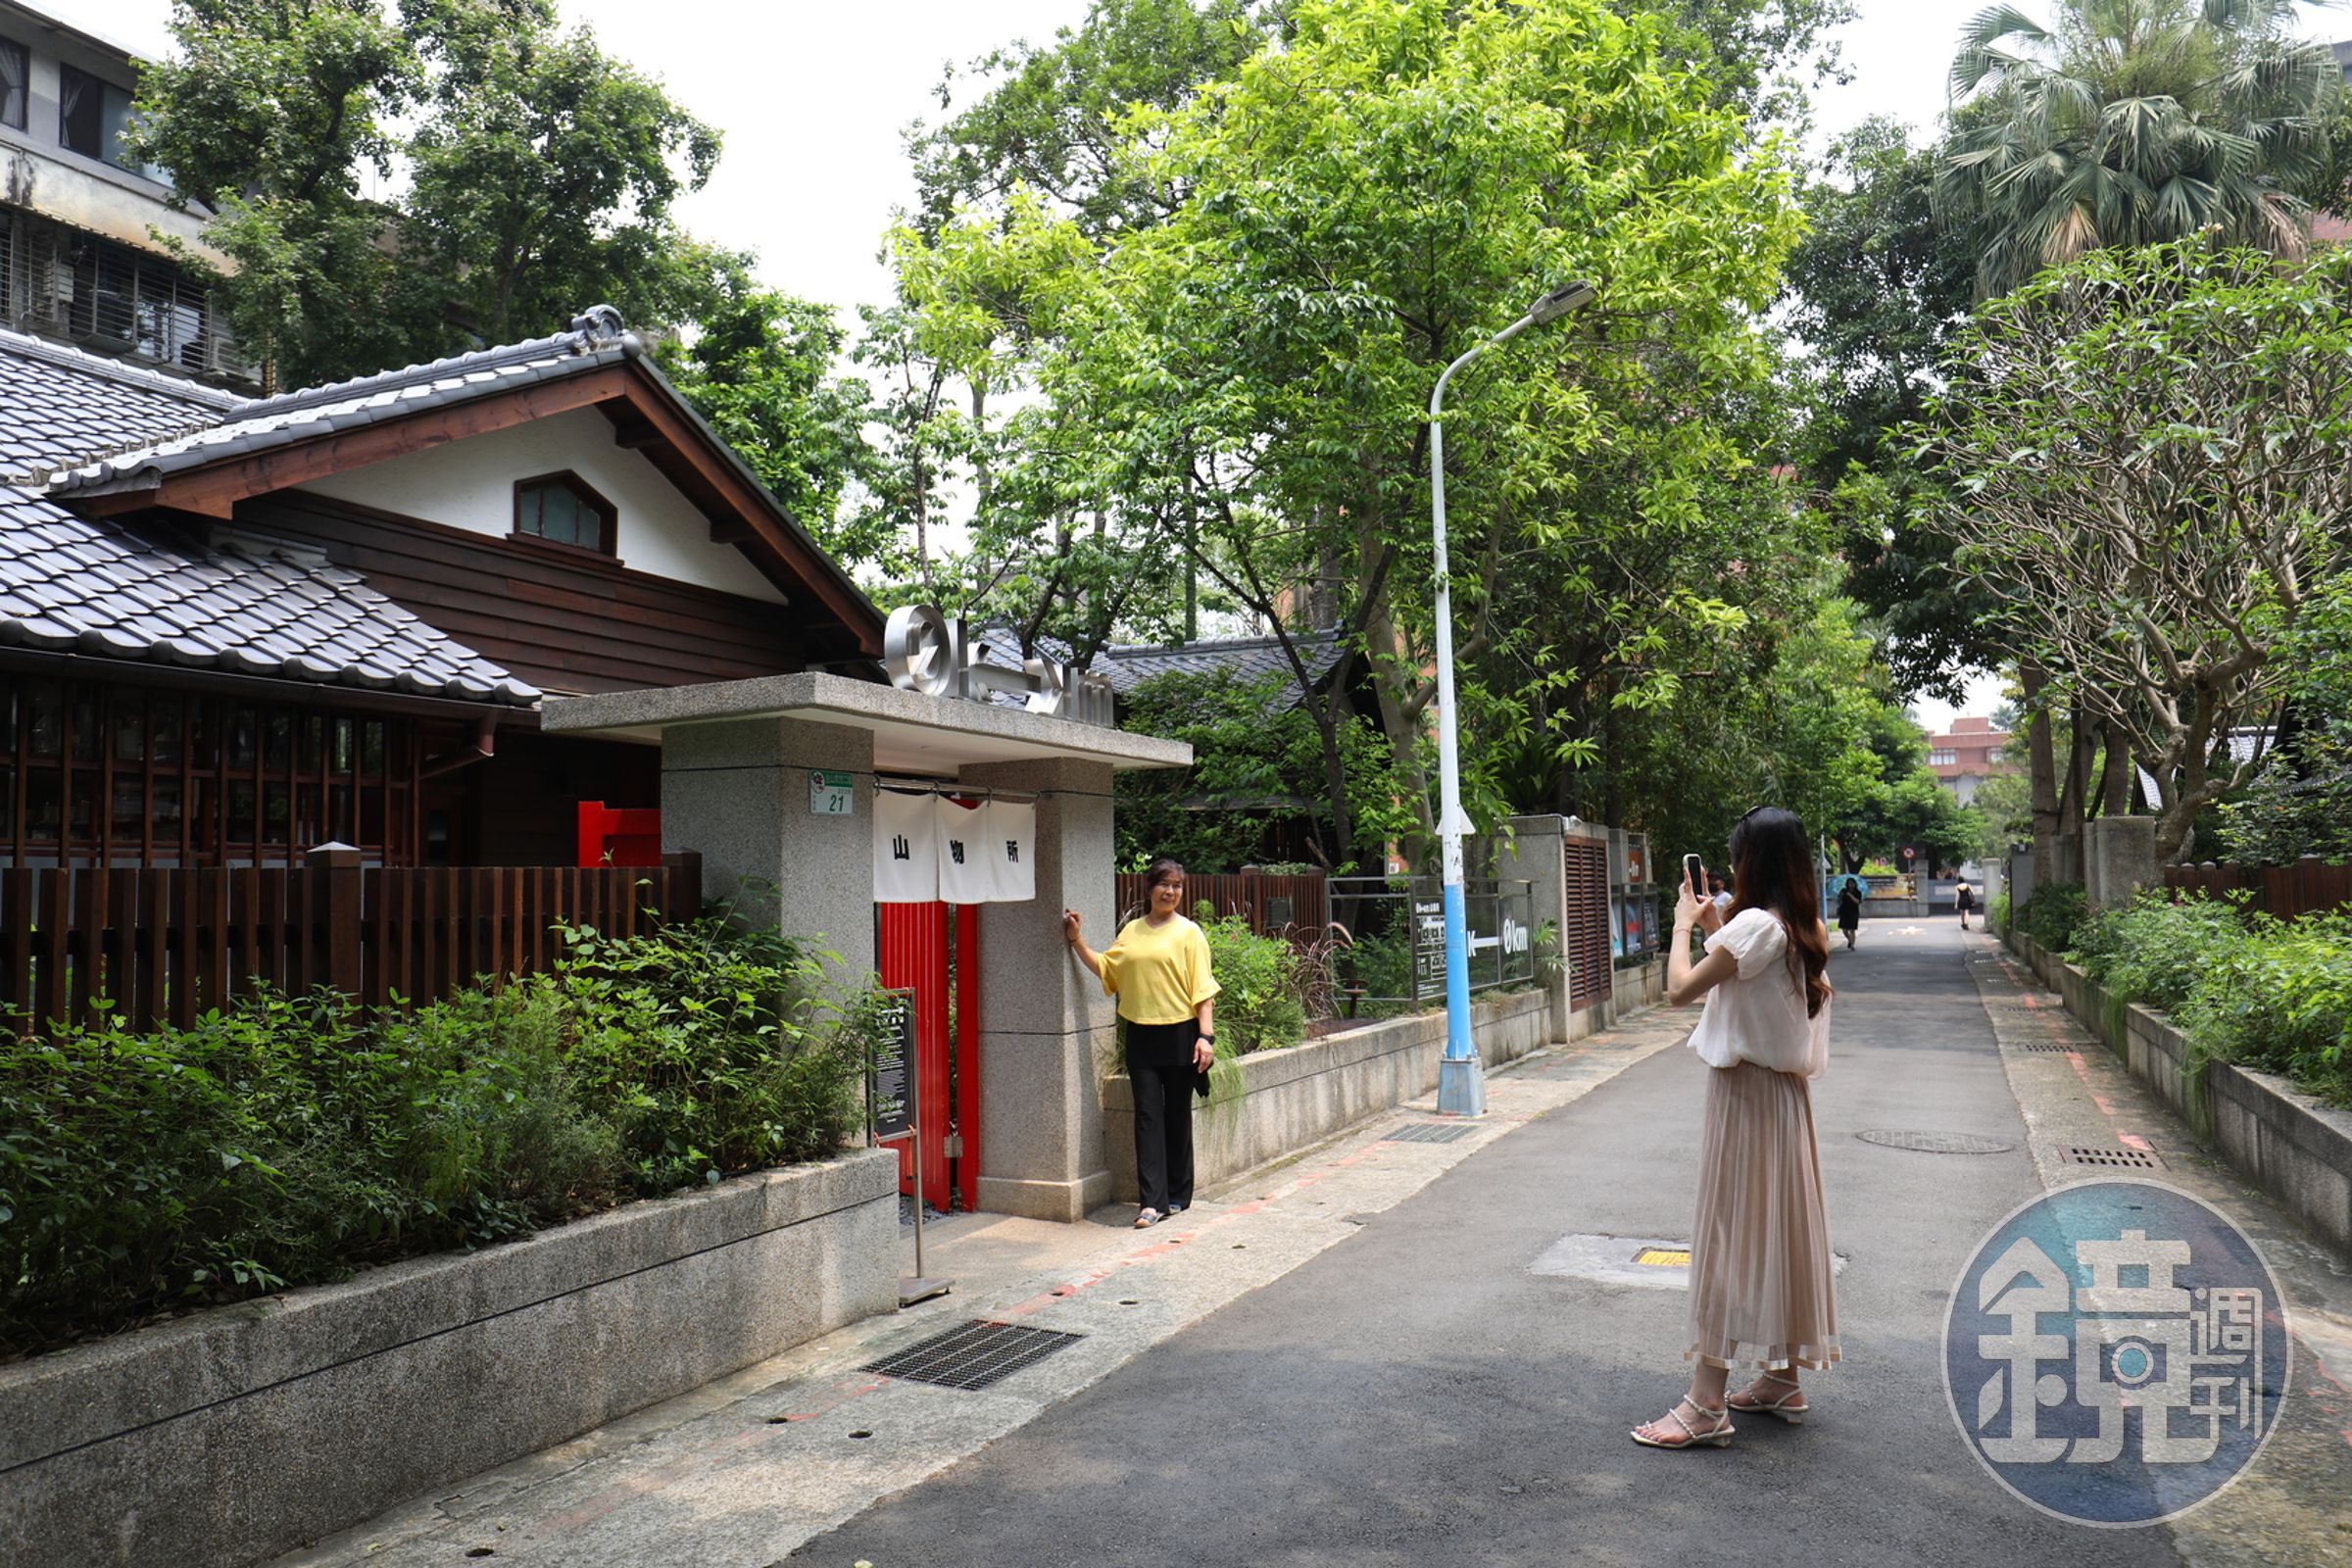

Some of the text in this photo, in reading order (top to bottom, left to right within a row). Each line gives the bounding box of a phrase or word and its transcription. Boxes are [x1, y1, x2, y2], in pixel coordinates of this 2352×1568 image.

[829, 794, 844, 812] 21
[893, 834, 1019, 864] 山物所
